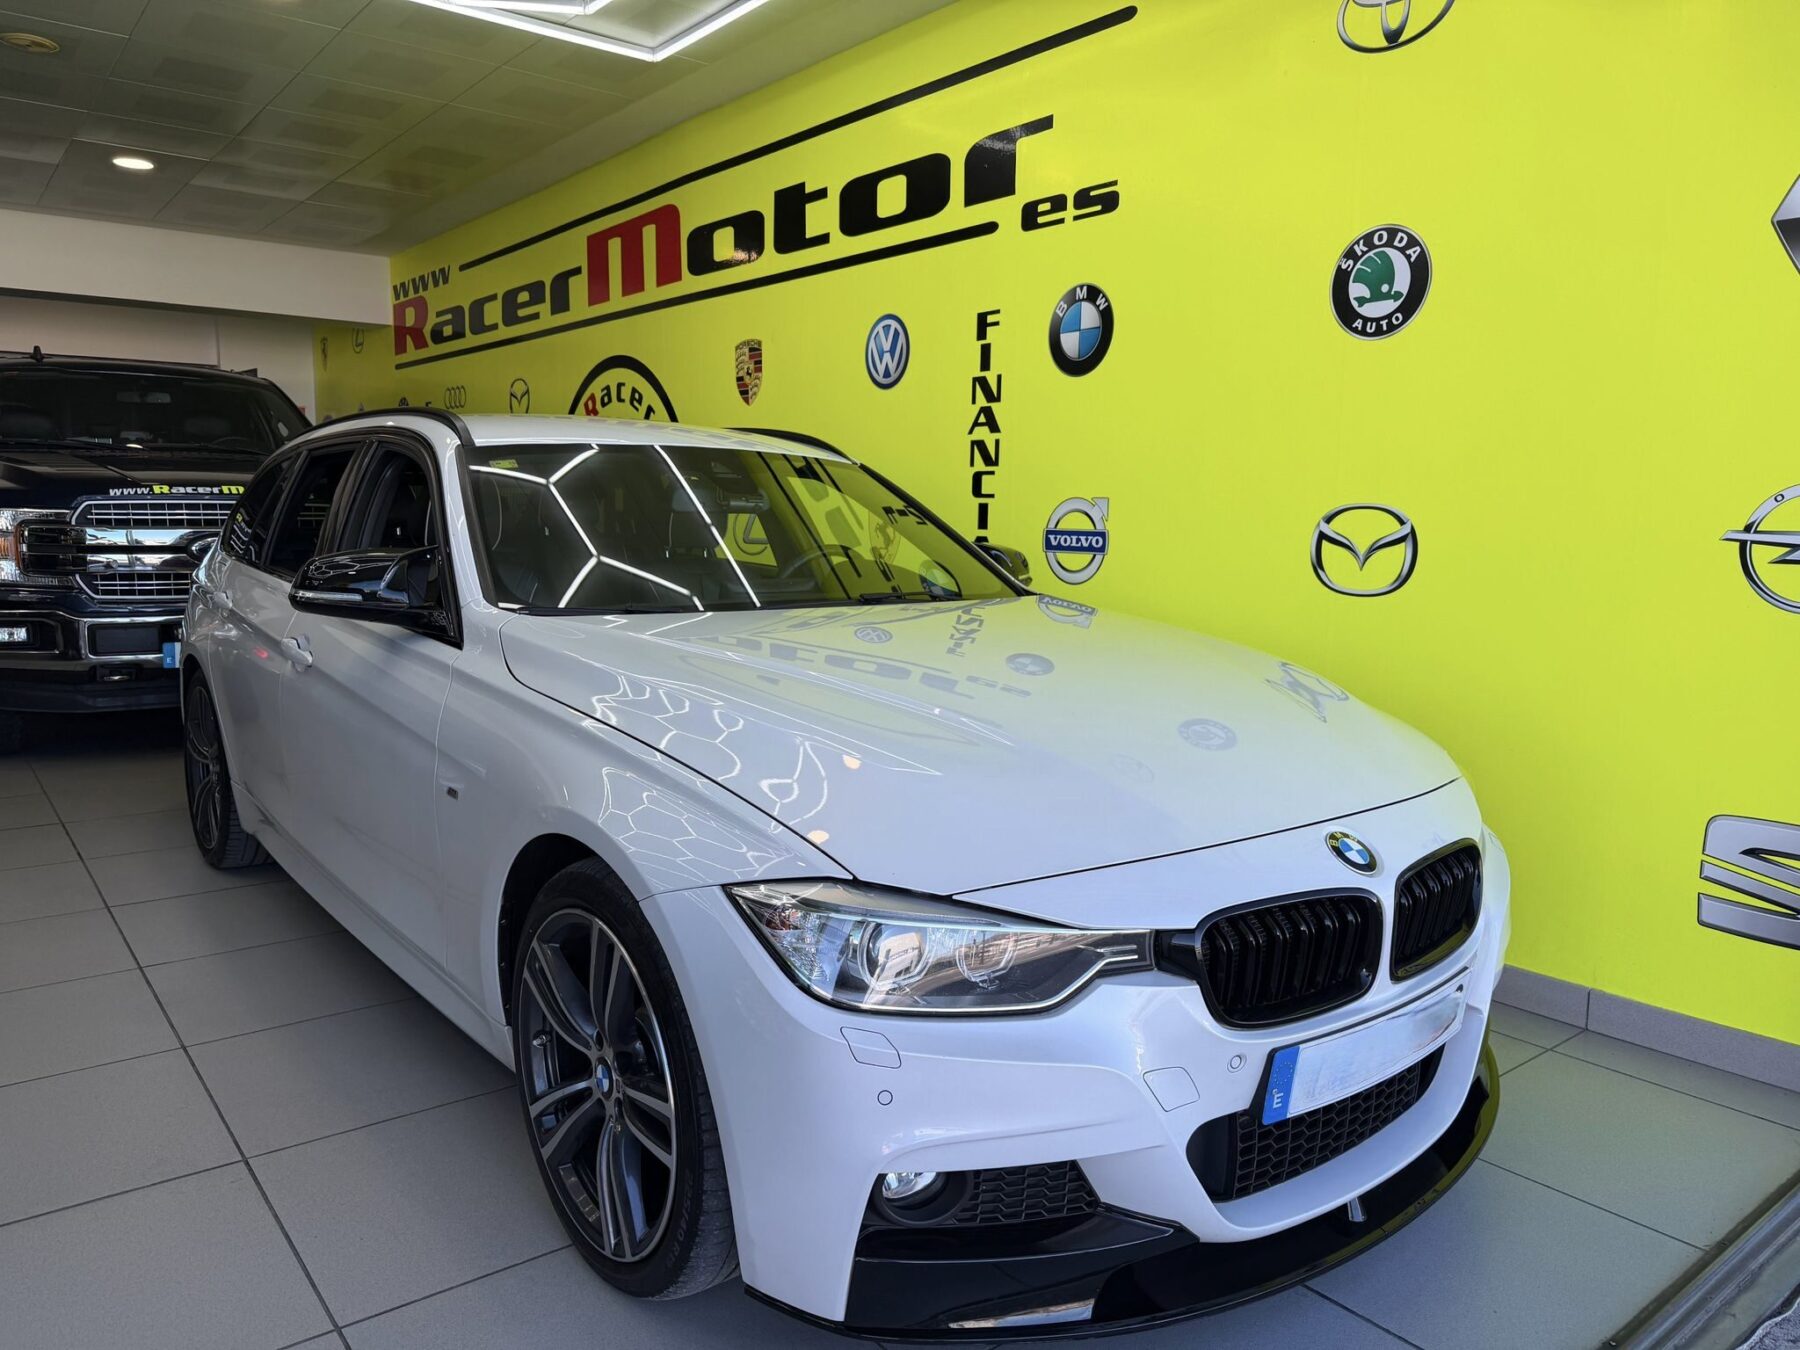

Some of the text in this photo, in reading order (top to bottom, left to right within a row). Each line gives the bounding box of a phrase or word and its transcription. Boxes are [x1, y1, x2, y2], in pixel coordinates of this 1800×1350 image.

[1021, 179, 1119, 232] es
[393, 265, 450, 301] www
[1056, 285, 1109, 318] BMW
[1352, 312, 1403, 334] AUTO
[967, 309, 1002, 543] FINANCI
[1048, 535, 1103, 548] VOLVO
